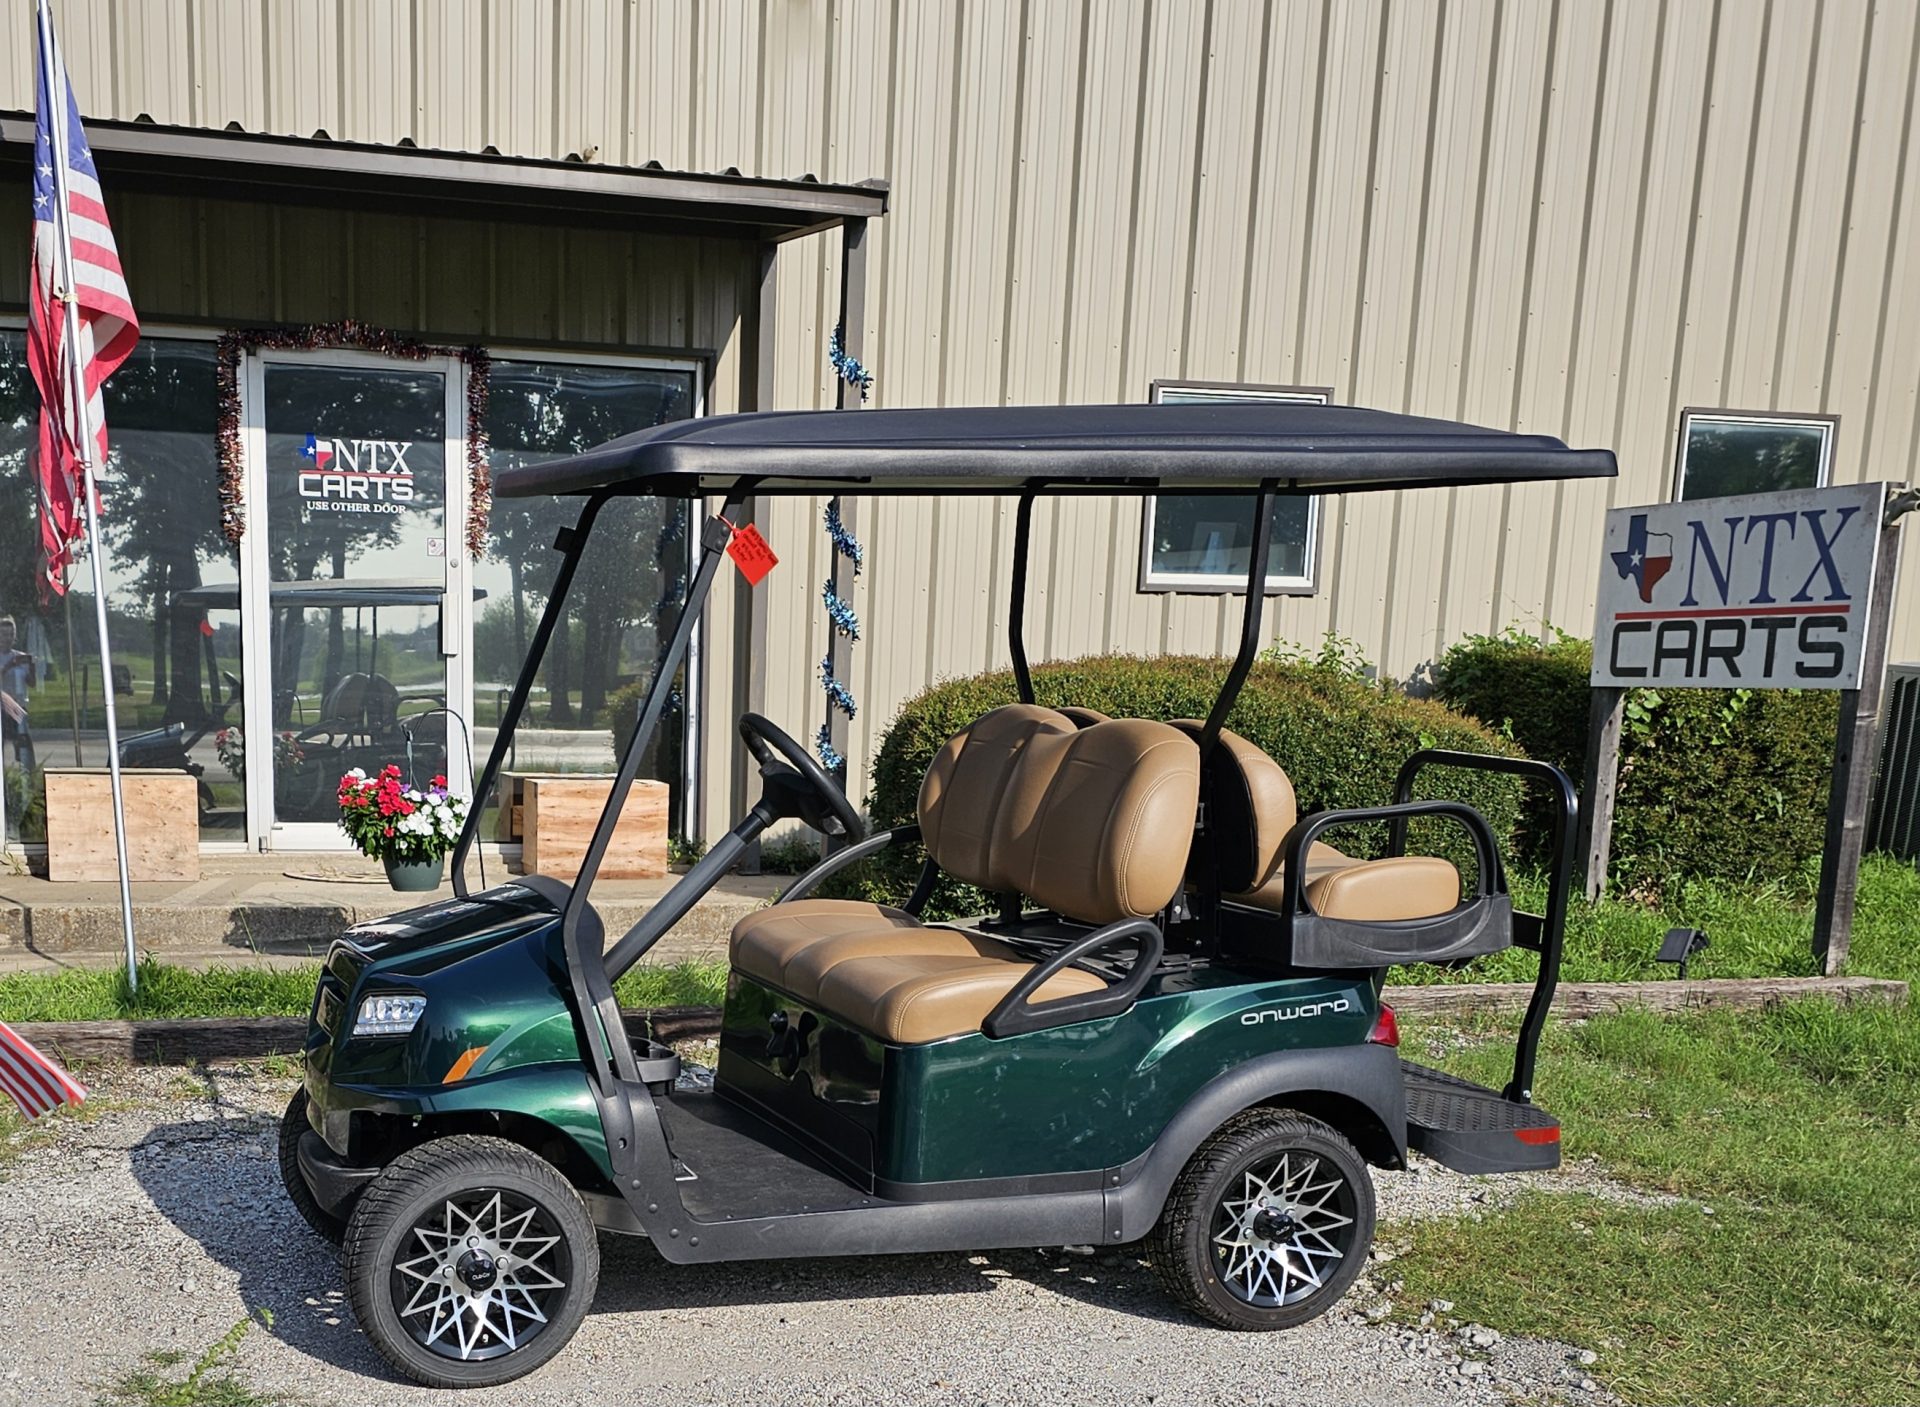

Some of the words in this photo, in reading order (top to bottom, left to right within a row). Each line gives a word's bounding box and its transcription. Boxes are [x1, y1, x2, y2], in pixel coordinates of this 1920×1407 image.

[332, 439, 413, 475] NTX
[298, 473, 414, 500] CARTS
[306, 501, 330, 511] USE
[331, 502, 371, 512] OTHER
[373, 503, 406, 513] DOOR
[1680, 506, 1861, 607] NTX
[1609, 615, 1848, 679] CARTS
